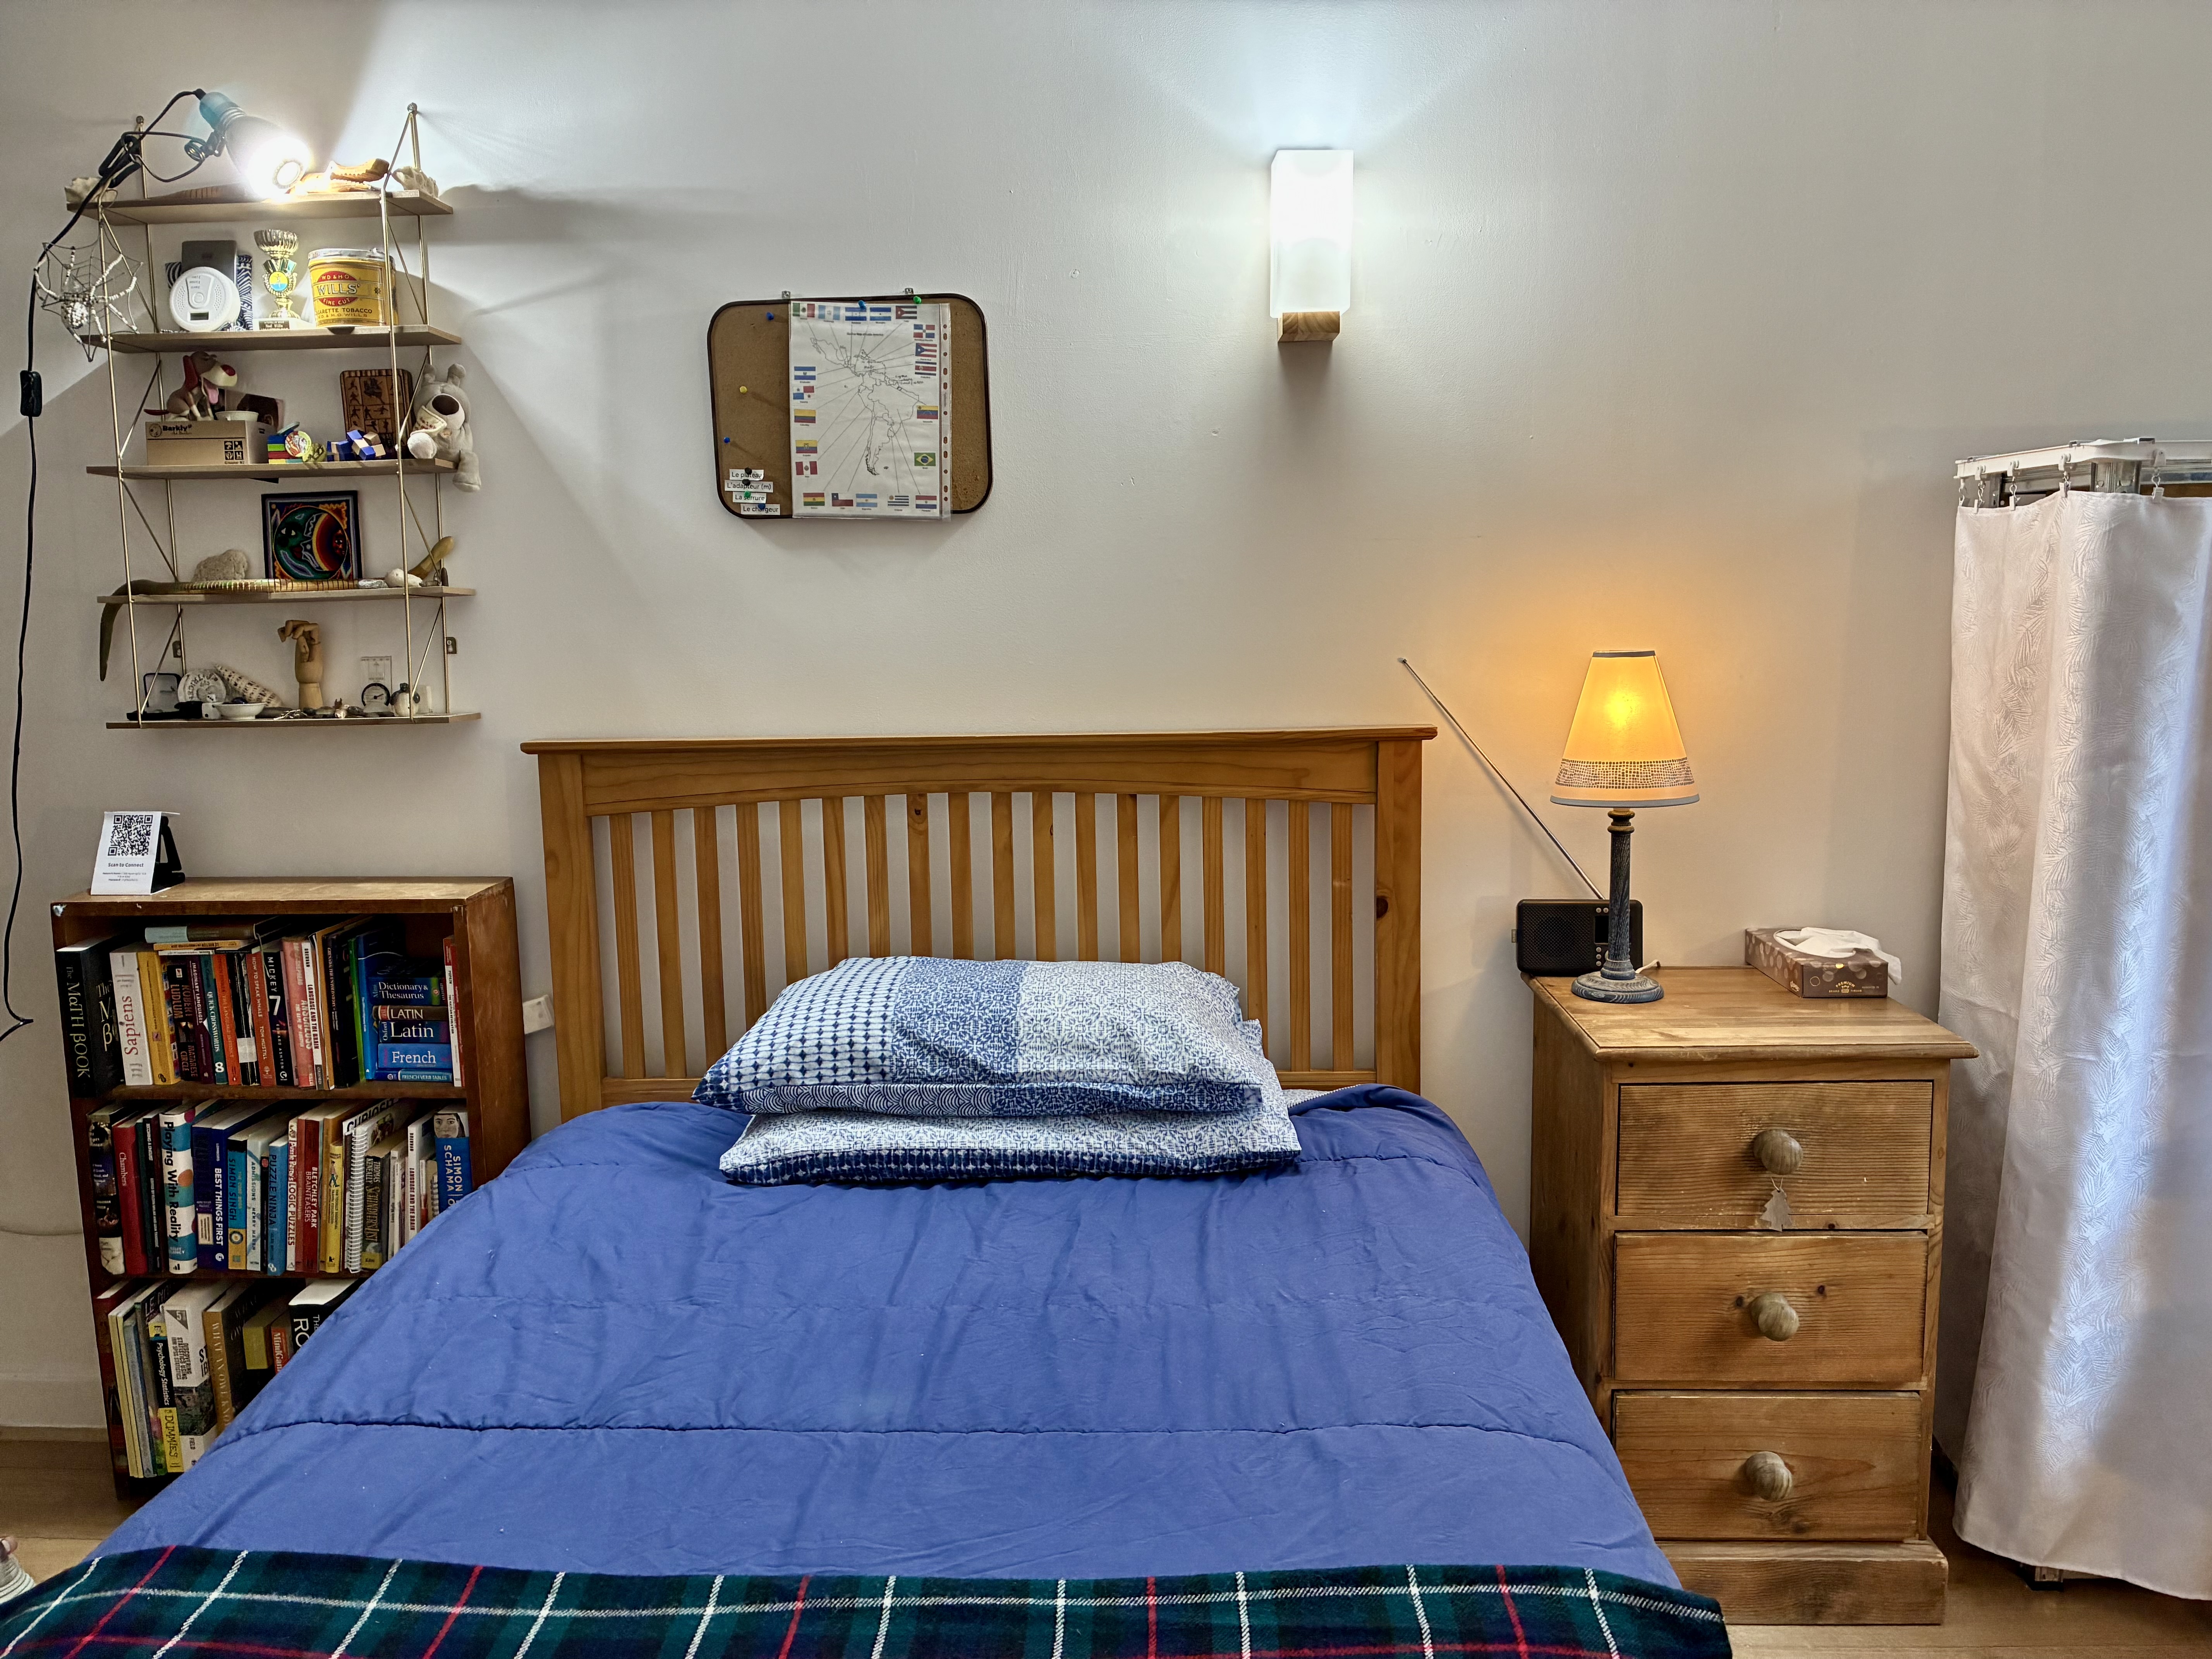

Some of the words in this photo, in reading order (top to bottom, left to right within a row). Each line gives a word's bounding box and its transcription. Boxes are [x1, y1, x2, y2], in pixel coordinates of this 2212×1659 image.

[317, 283, 361, 296] WILLS'
[338, 297, 350, 305] CUT
[254, 971, 258, 979] TO
[268, 957, 277, 992] MICKEY
[379, 982, 422, 992] Dictionary
[170, 984, 183, 1018] LUDLUM
[182, 985, 193, 1016] ROBERT
[307, 984, 316, 1010] LANGUAGE
[379, 990, 424, 999] Thesaurus
[122, 996, 141, 1055] Sapiens
[390, 1009, 423, 1019] LATIN
[210, 1011, 220, 1052] CROSSWORDS
[390, 1022, 434, 1038] Latin
[180, 1051, 189, 1071] CIRCLE
[215, 1062, 224, 1073] 8
[392, 1051, 436, 1063] French
[164, 1121, 175, 1166] Playing
[119, 1152, 128, 1186] Chambers
[444, 1145, 454, 1192] SCHAMA
[453, 1156, 463, 1191] SIMON
[168, 1169, 179, 1198] With
[289, 1183, 297, 1207] LOGIC
[169, 1201, 181, 1242] Reality
[288, 1211, 296, 1245] PUZZLES
[176, 1311, 181, 1320] 5
[212, 1322, 222, 1351] WHAT
[177, 1337, 186, 1364] STATISTICS
[216, 1358, 224, 1370] AN
[156, 1343, 165, 1377] Psychology
[161, 1377, 170, 1406] Statistics
[219, 1374, 228, 1394] OWL
[165, 1415, 178, 1458] DUMMIES
